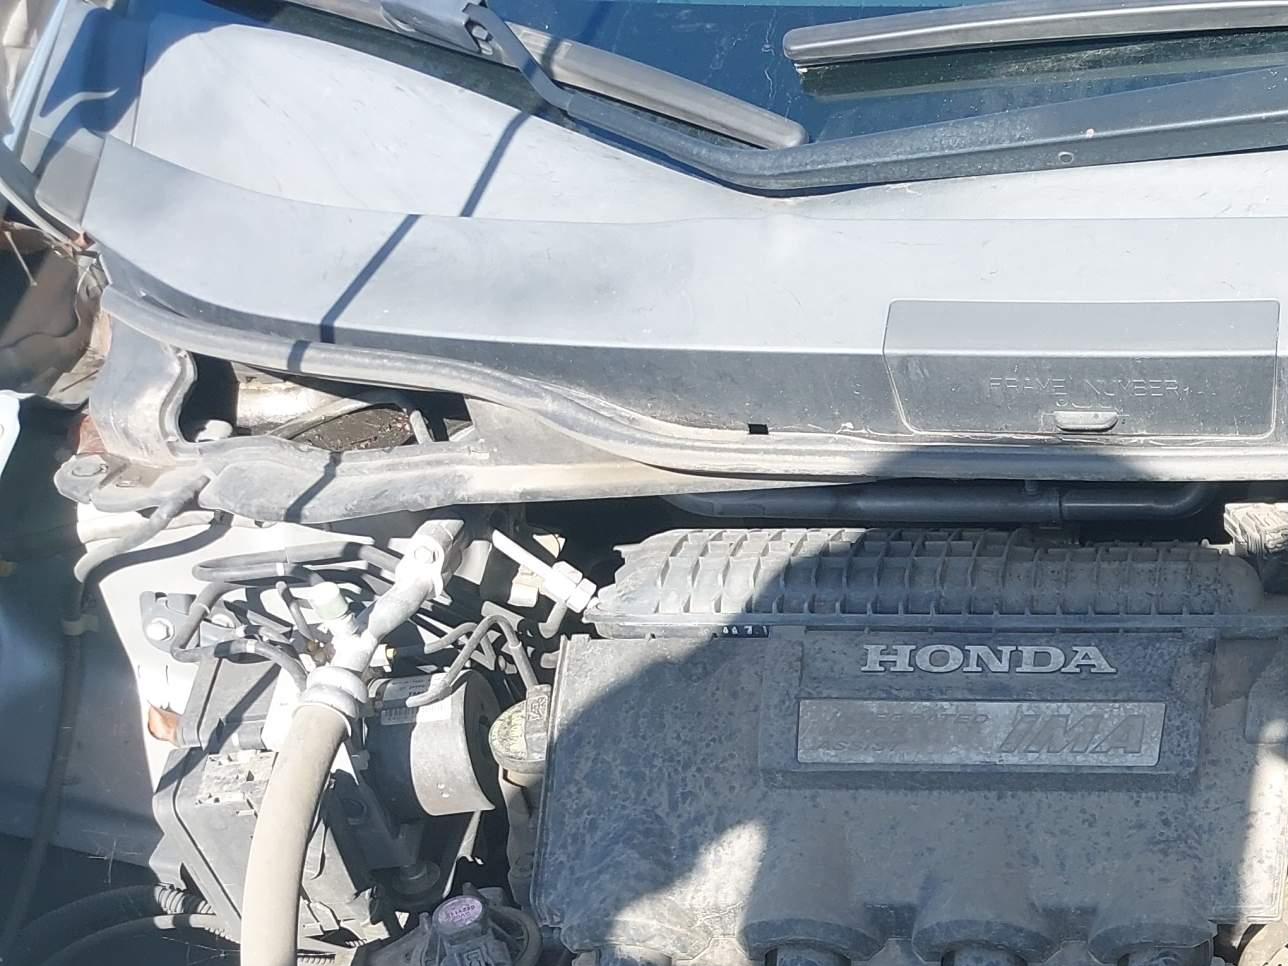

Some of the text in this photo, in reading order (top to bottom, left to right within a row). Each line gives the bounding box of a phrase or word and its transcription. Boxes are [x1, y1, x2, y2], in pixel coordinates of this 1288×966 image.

[988, 377, 1182, 397] FRAME NUMBER
[861, 644, 1117, 674] HONDA
[1000, 713, 1146, 754] IMA
